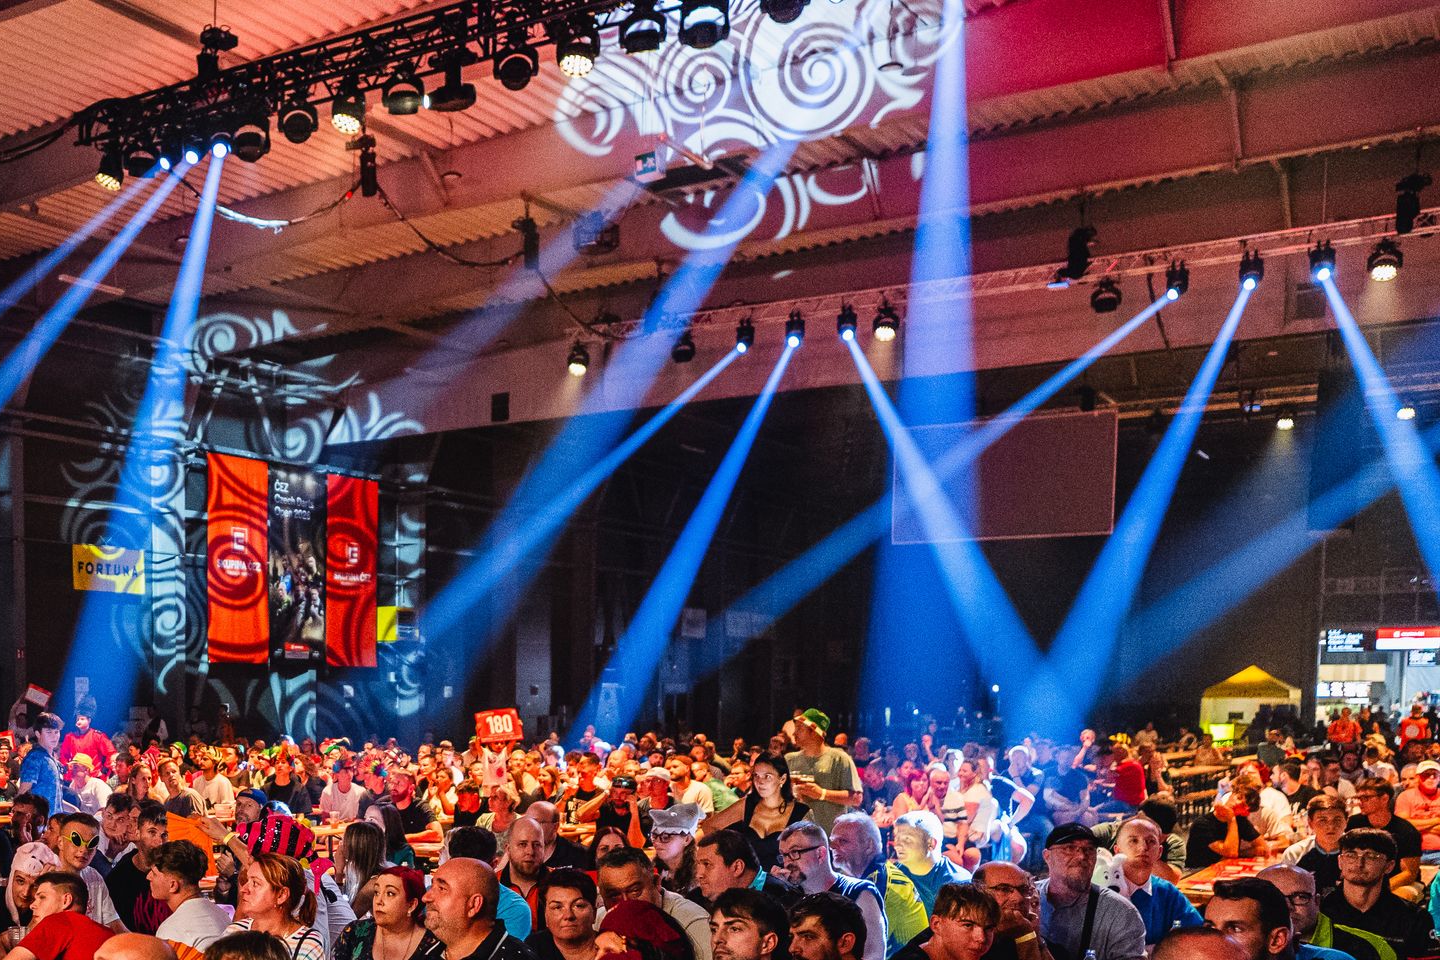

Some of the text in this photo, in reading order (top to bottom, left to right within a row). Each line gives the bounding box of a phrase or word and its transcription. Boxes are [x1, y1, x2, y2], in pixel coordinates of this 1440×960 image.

[274, 479, 289, 493] ČEZ
[77, 561, 138, 578] FORTUNA
[486, 714, 513, 734] 180
